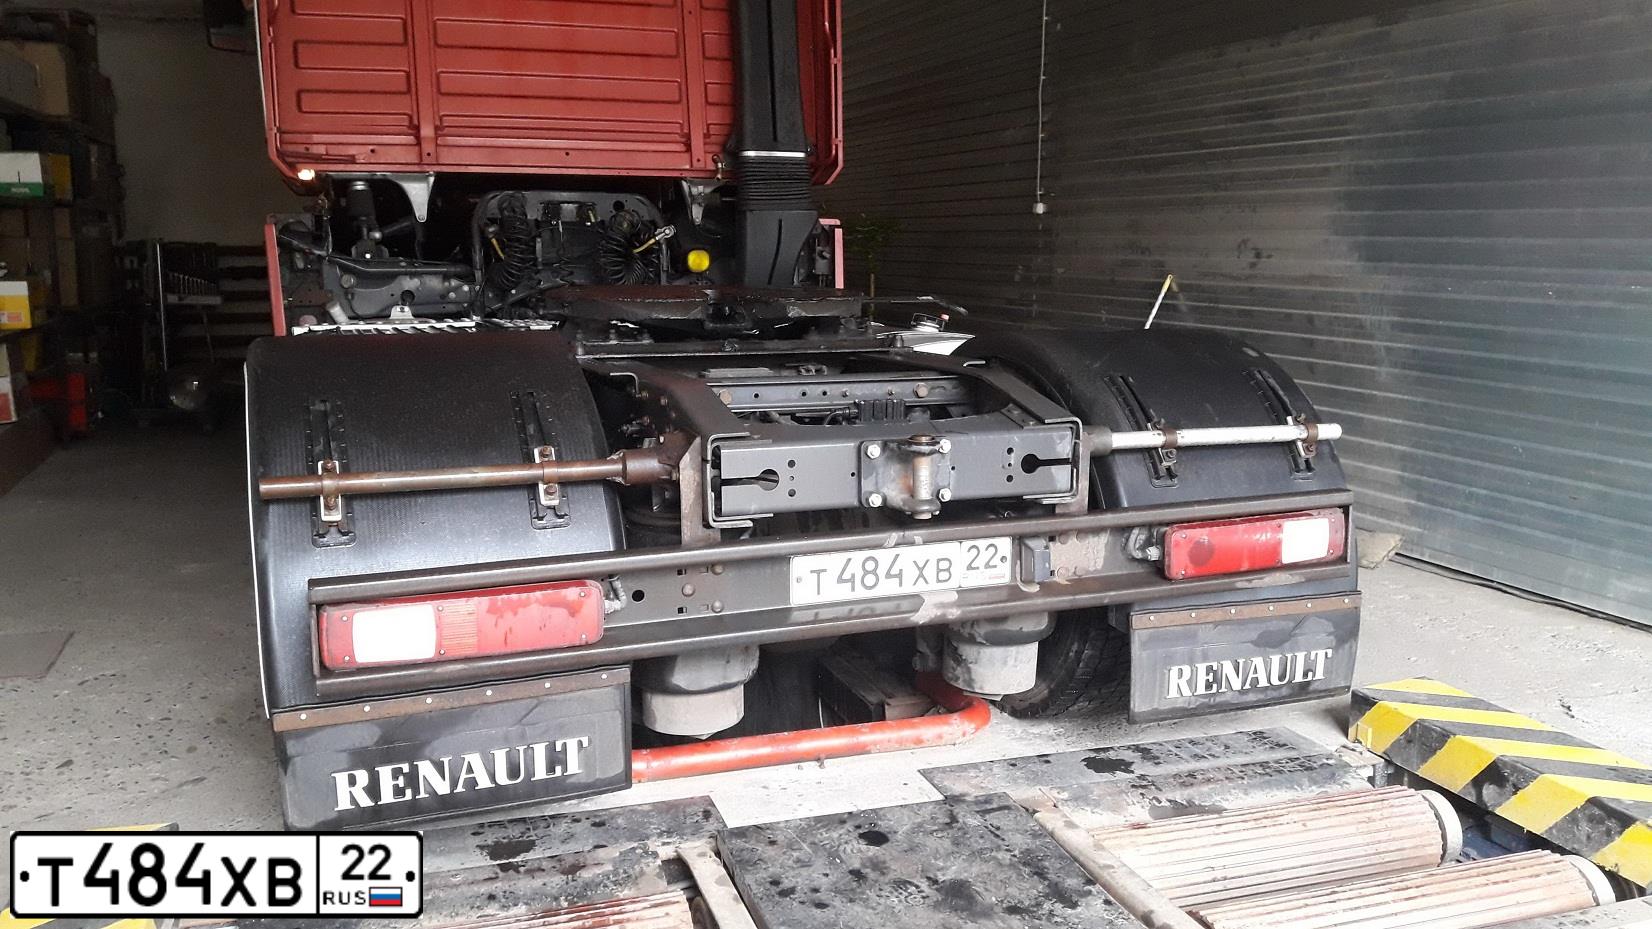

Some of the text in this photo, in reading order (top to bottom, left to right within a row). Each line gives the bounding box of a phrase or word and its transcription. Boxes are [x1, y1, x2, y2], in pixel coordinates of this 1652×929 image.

[966, 543, 999, 571] 22
[1167, 649, 1333, 698] RENAULT
[331, 736, 589, 810] RENAULT
